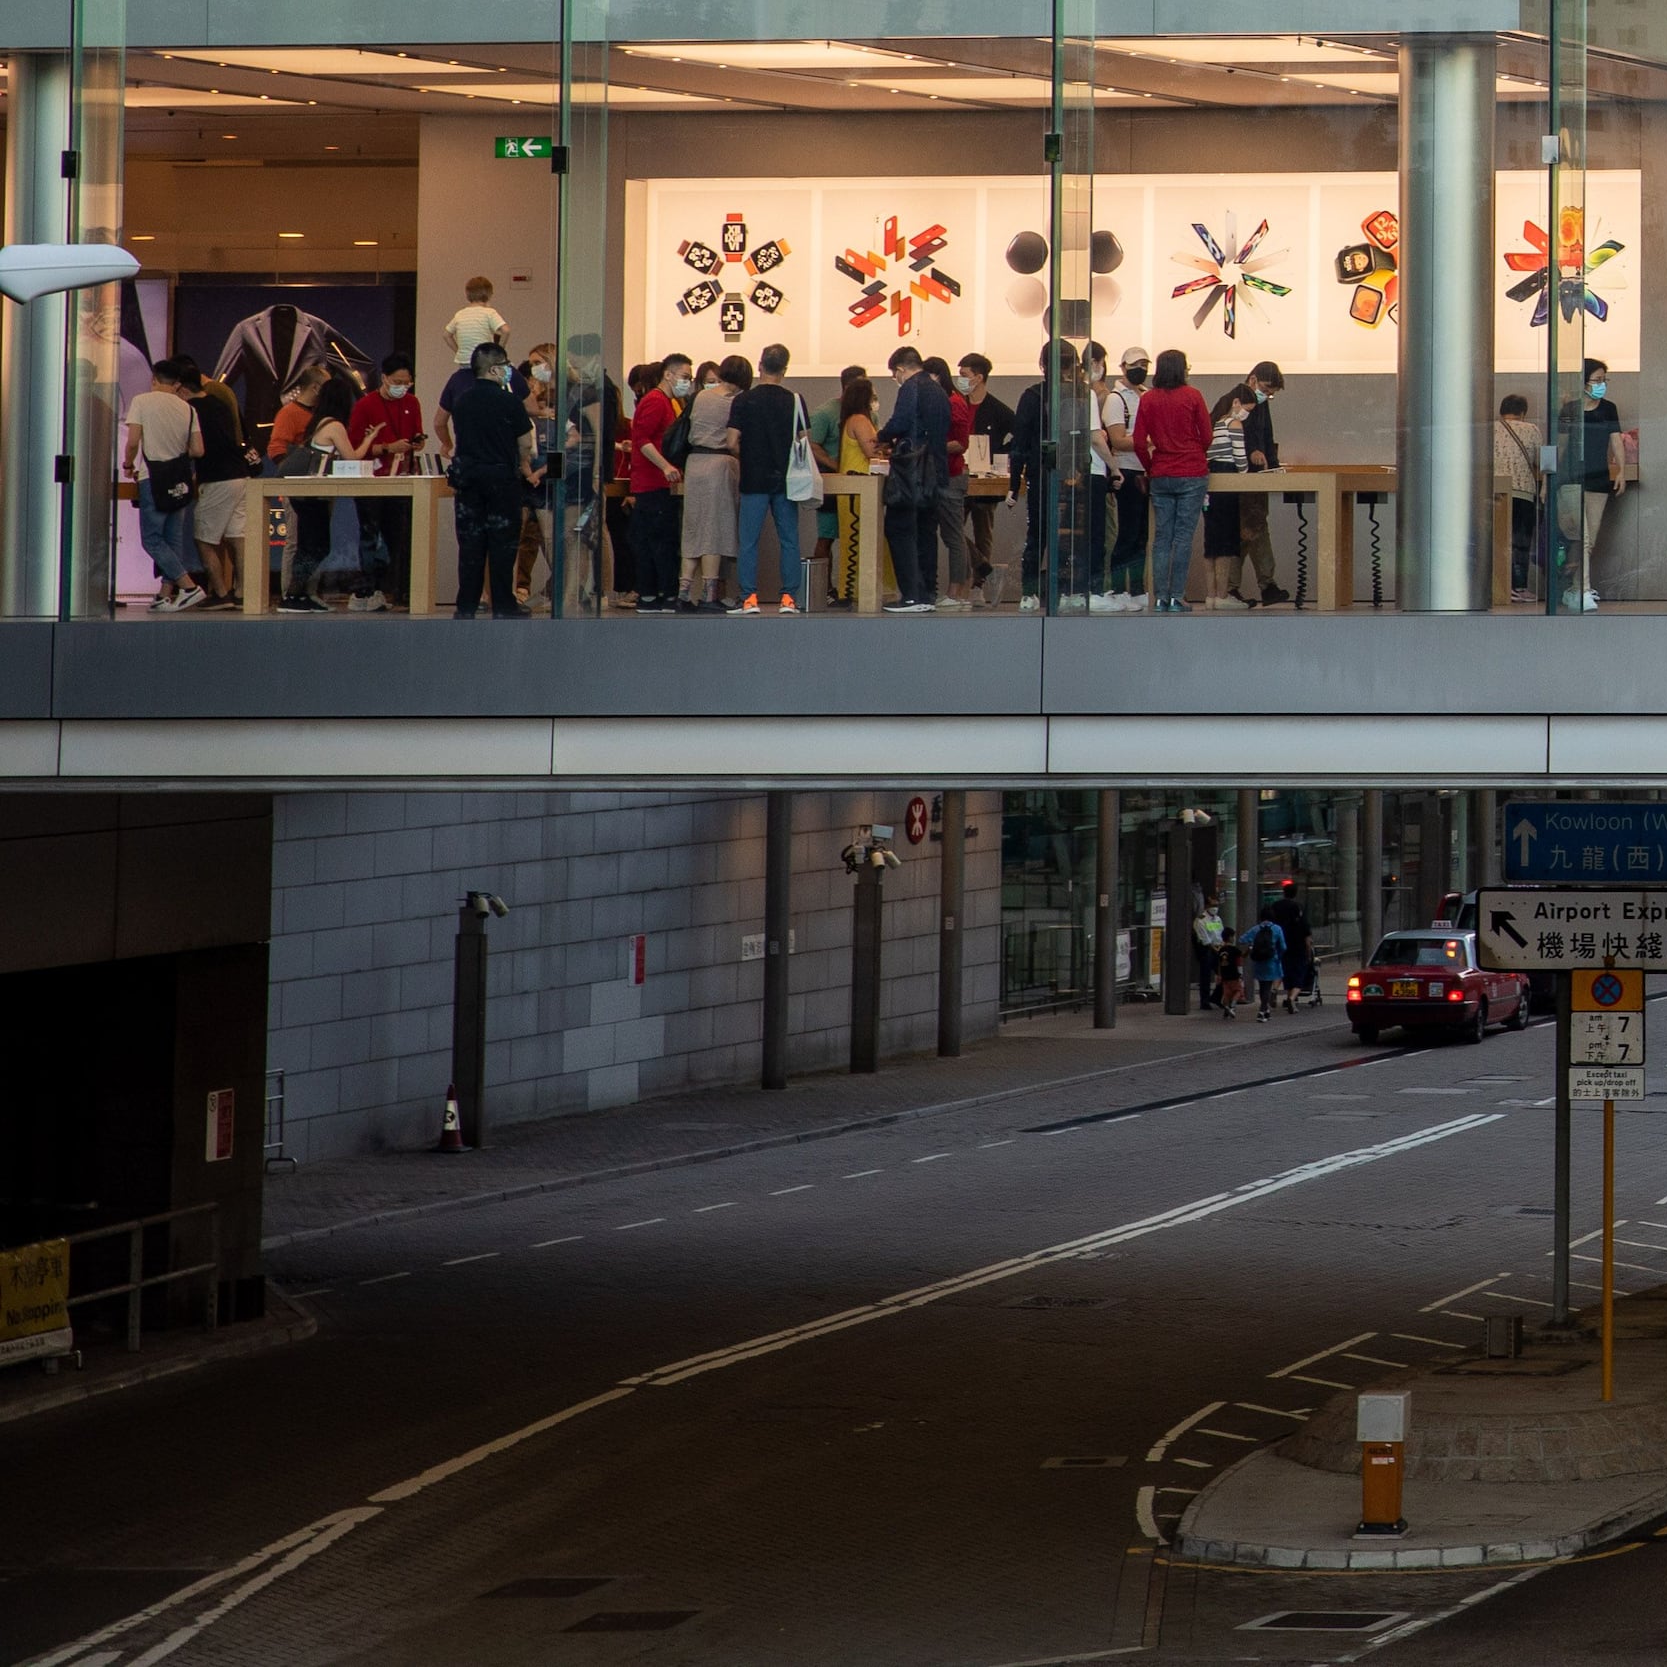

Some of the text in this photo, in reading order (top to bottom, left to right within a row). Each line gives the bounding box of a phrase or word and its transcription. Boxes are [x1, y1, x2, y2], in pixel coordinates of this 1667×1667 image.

[1546, 813, 1632, 830] Kowloon
[1534, 903, 1610, 922] Airport
[1618, 1016, 1629, 1033] 7
[1618, 1044, 1629, 1061] 7
